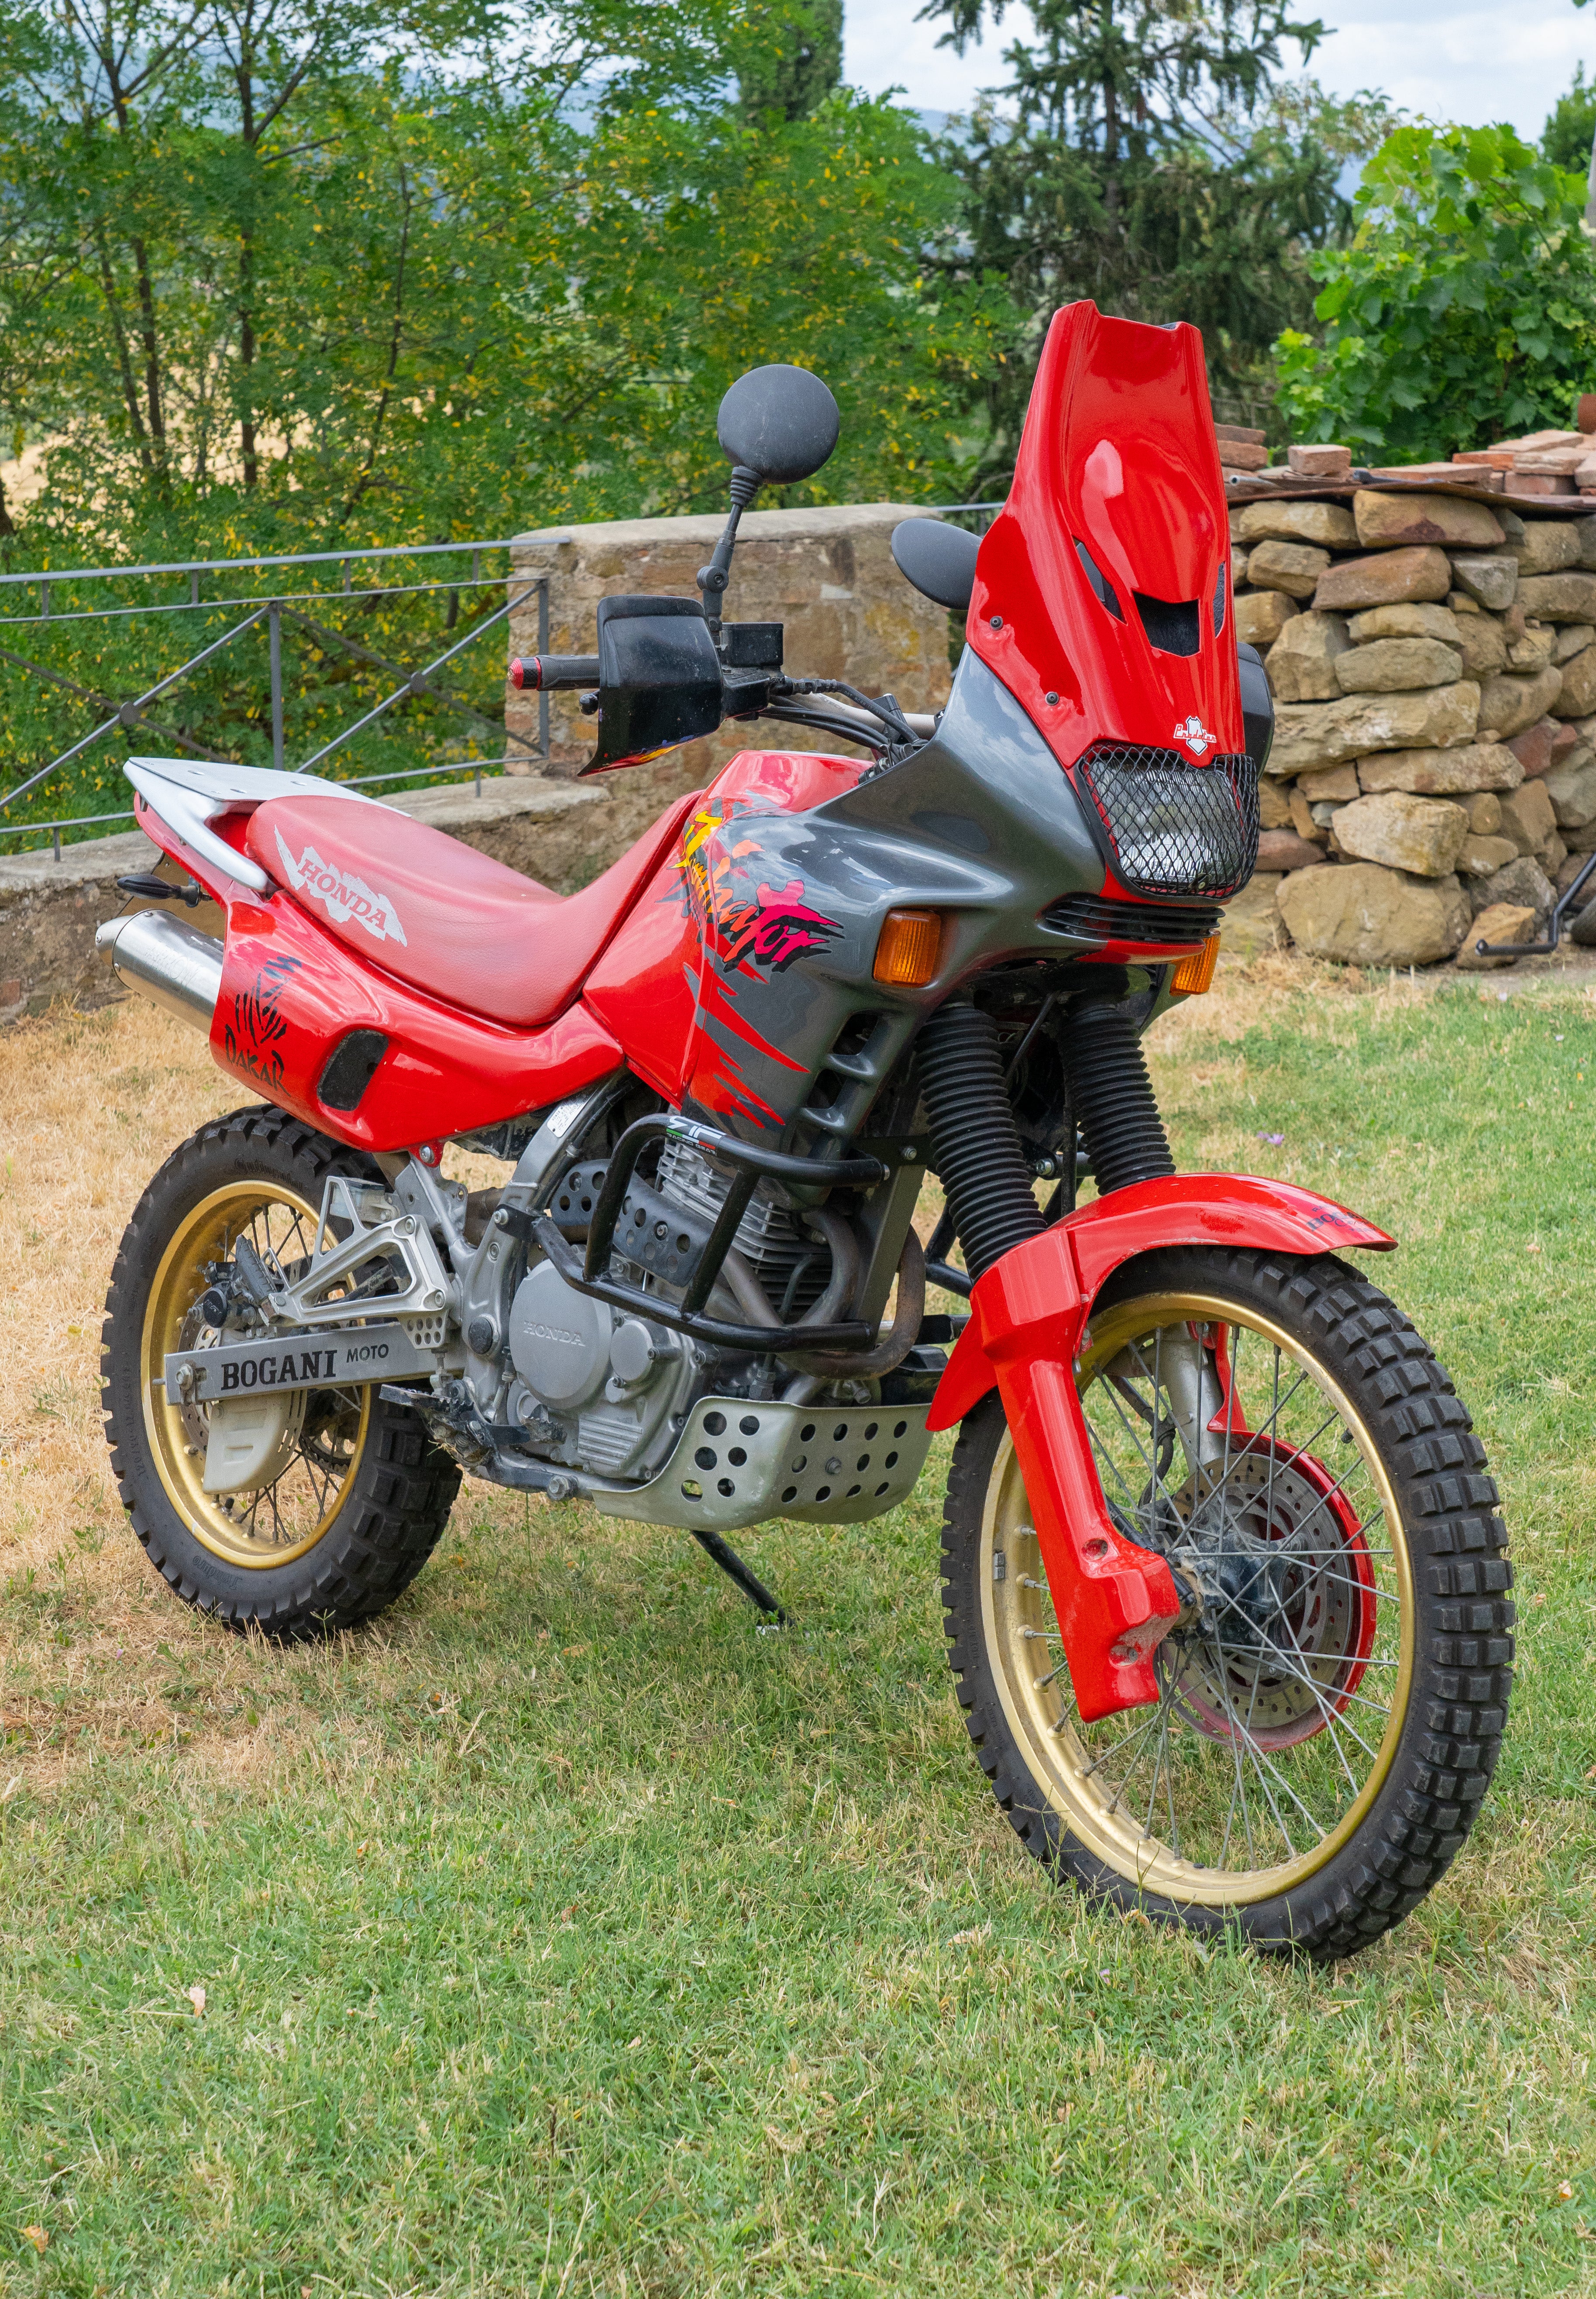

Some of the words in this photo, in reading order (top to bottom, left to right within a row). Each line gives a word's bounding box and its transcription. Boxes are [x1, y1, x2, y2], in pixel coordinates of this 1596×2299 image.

[1174, 724, 1217, 742] Predator
[298, 858, 386, 931] HONDA
[225, 1023, 291, 1097] DAKAR
[695, 1143, 717, 1157] GEAR
[523, 1320, 586, 1347] HONDA
[221, 1350, 338, 1391] BOGANI
[346, 1344, 389, 1364] MOTO
